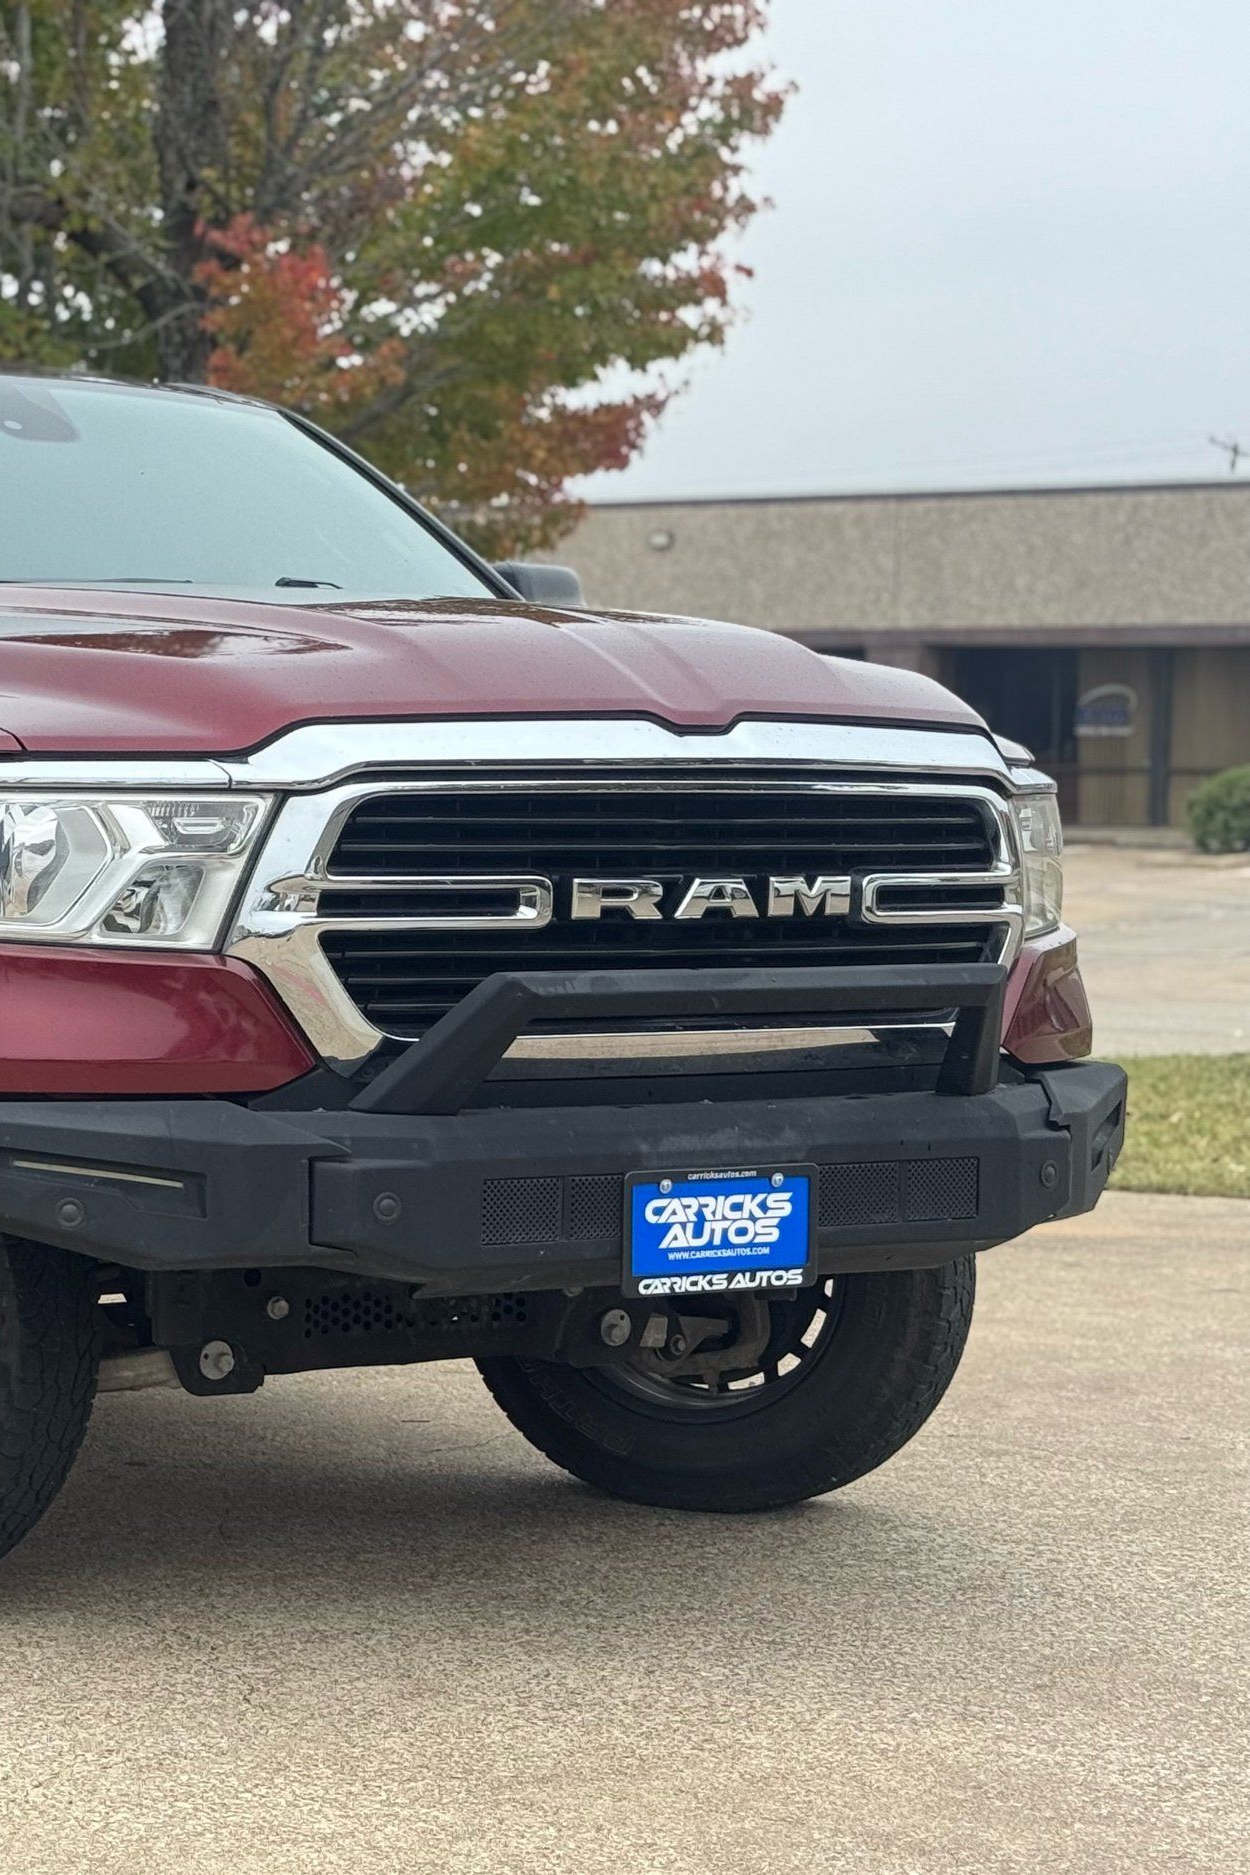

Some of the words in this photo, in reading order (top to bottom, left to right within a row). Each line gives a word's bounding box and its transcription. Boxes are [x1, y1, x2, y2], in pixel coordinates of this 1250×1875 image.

[571, 875, 852, 919] RAM
[687, 1169, 757, 1181] carricksautos.com
[645, 1191, 793, 1224] CARRICKS
[658, 1217, 782, 1249] AUTOS
[667, 1246, 770, 1261] WWW.CARRICKSAUTOS.COM
[638, 1272, 730, 1295] CARRICKS
[728, 1268, 804, 1290] AUTOS
